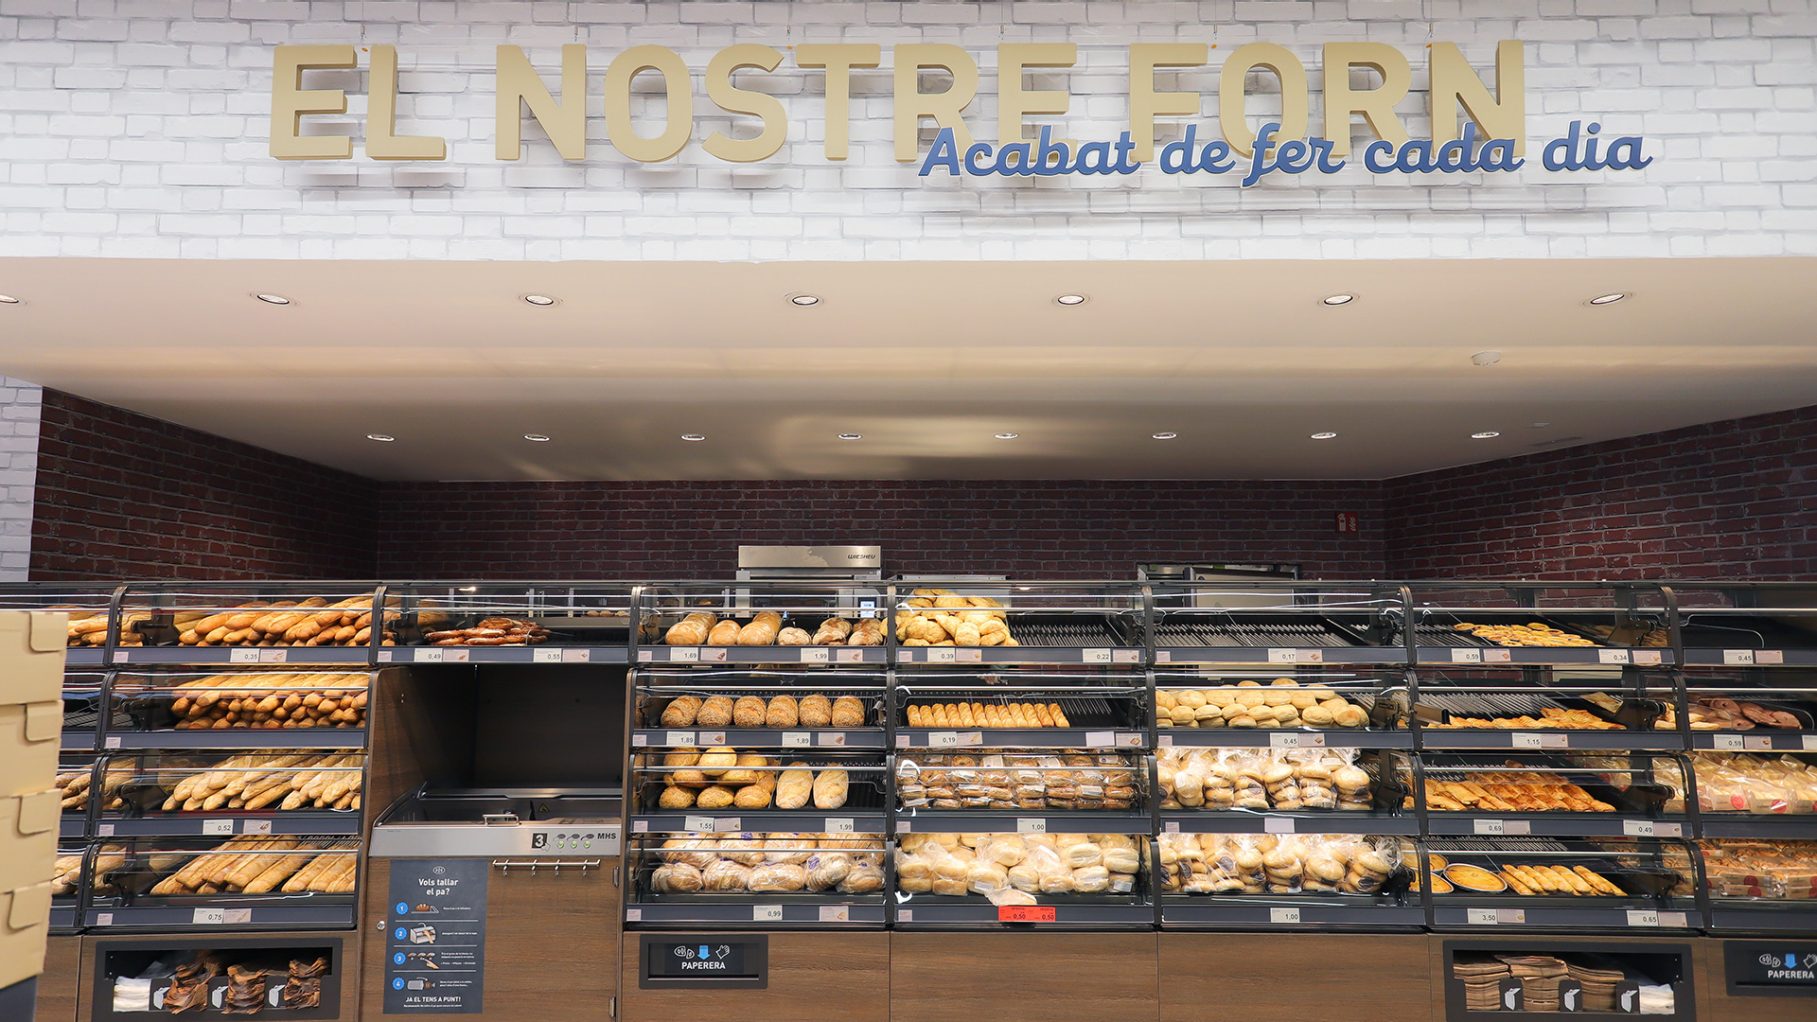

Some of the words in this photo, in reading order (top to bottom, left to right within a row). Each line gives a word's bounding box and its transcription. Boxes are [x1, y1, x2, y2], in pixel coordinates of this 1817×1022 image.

[269, 43, 446, 160] EL
[496, 43, 1077, 162] NOSTRE
[1130, 40, 1525, 161] FORN
[918, 125, 1142, 177] Acabat
[1160, 123, 1237, 174] de
[1241, 121, 1346, 188] fer
[1363, 120, 1525, 173] cada
[1541, 118, 1654, 172] dia
[418, 878, 435, 886] Vols
[437, 878, 459, 886] tallar
[435, 887, 450, 896] pa?
[681, 961, 726, 970] PAPERERA
[1767, 970, 1815, 979] PAPERERA
